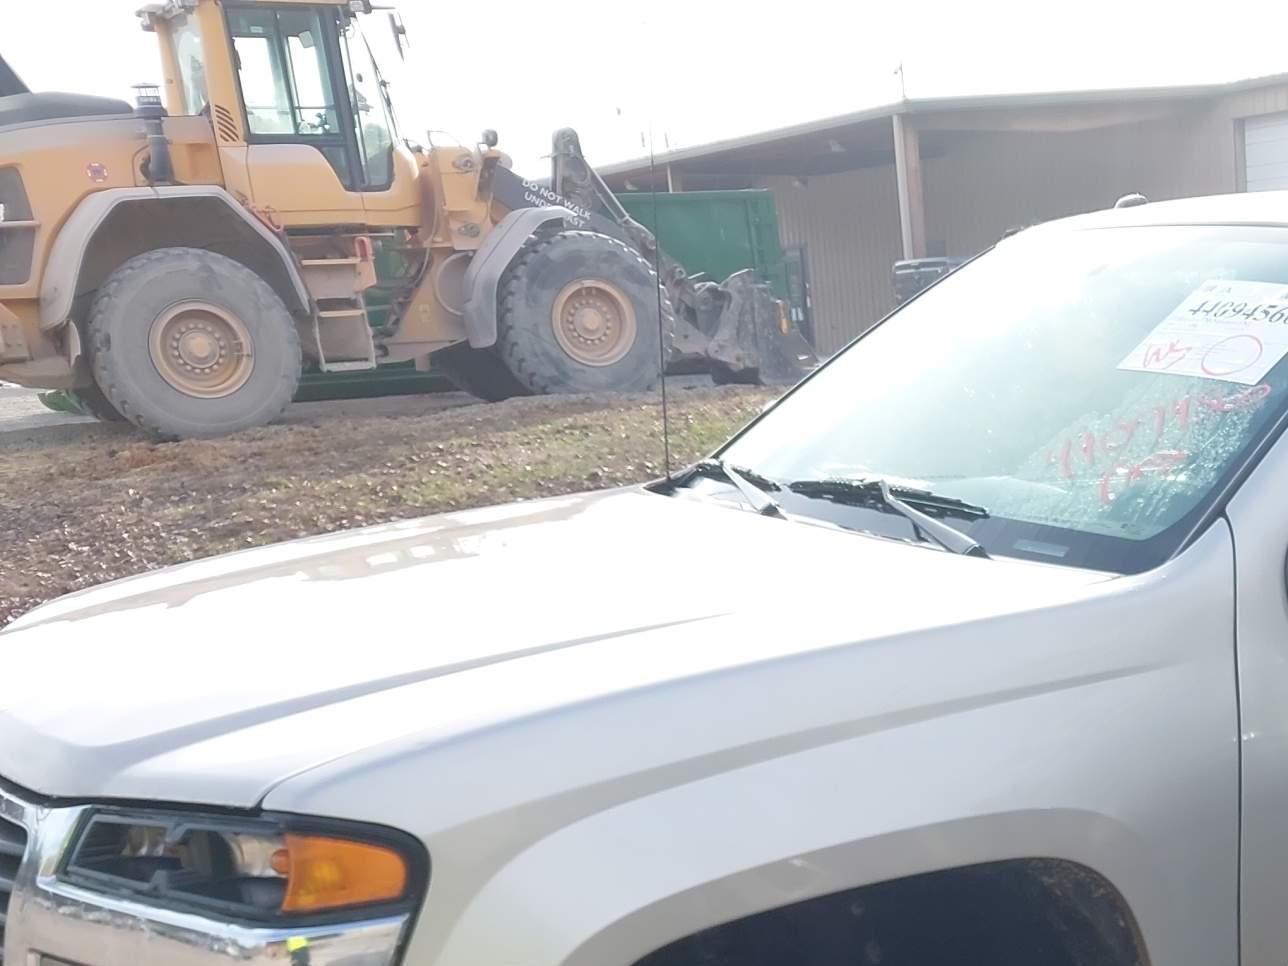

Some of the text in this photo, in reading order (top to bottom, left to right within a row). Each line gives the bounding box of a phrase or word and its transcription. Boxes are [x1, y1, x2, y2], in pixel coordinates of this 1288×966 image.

[522, 179, 591, 220] DO NOT WALK
